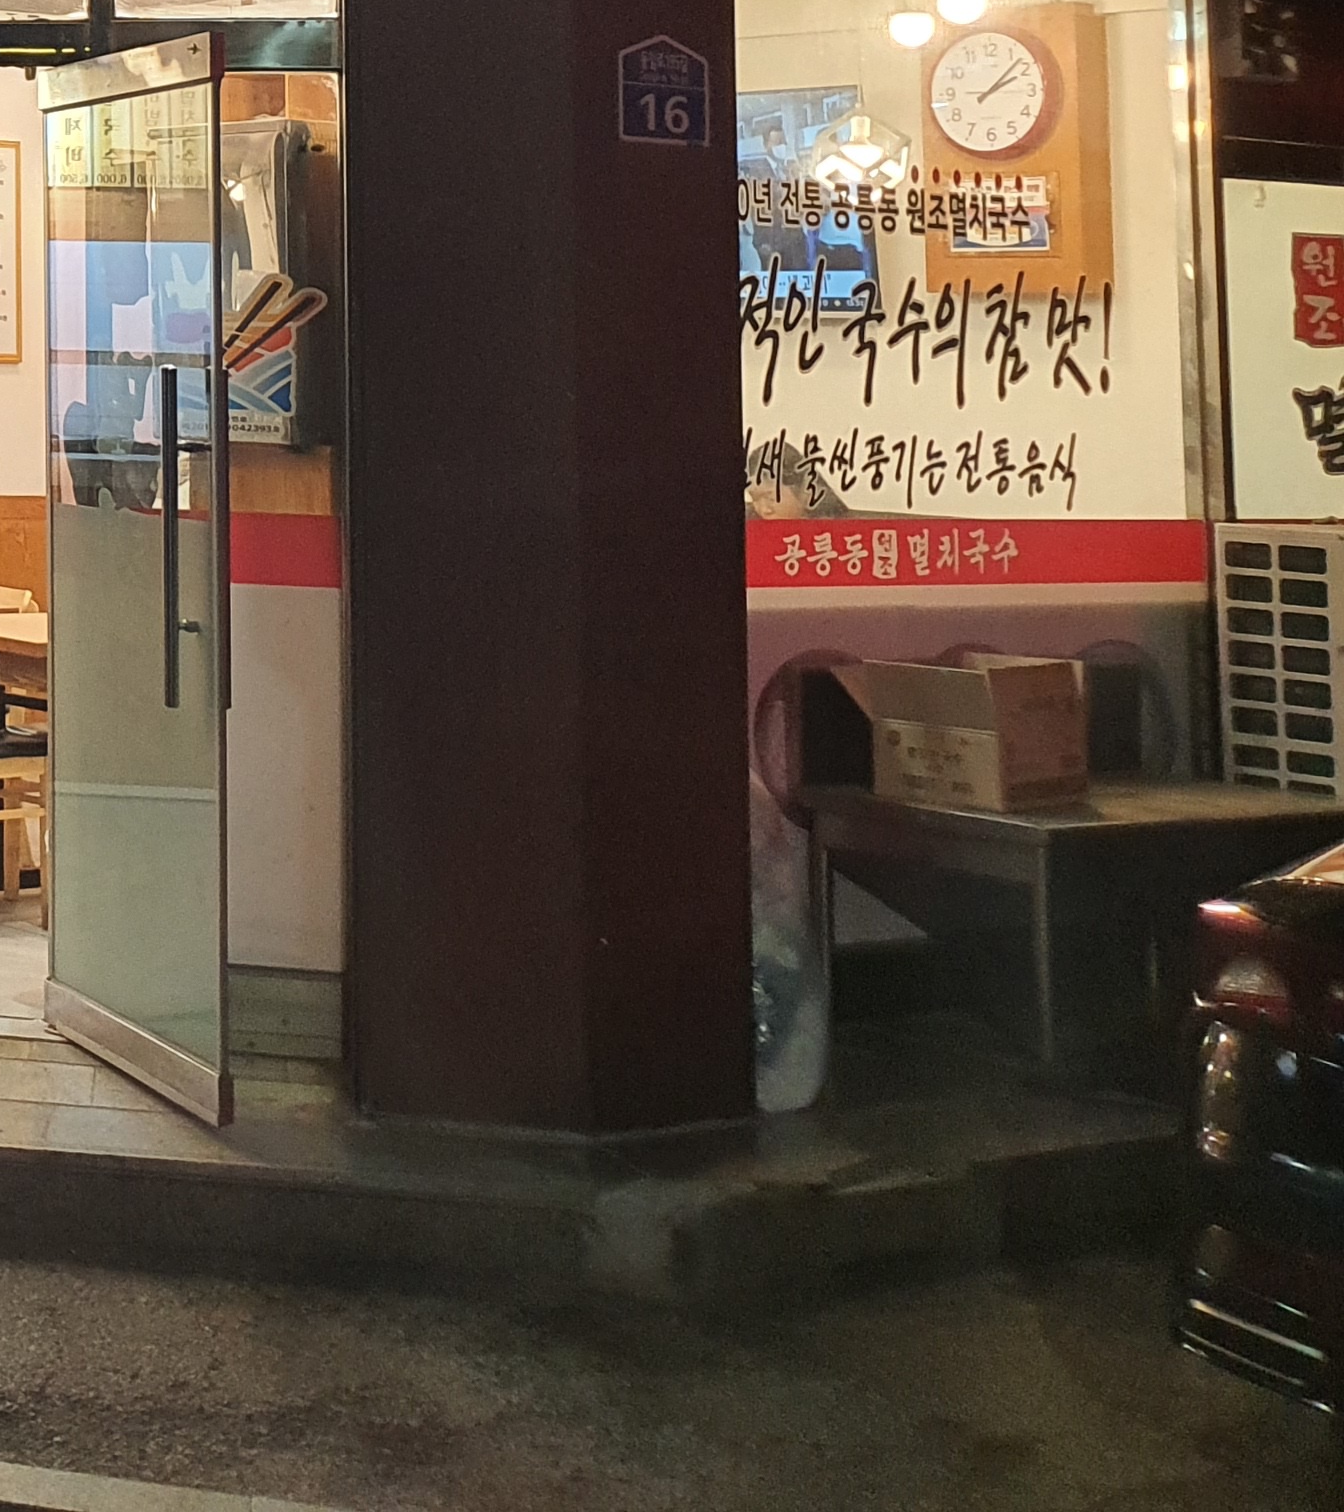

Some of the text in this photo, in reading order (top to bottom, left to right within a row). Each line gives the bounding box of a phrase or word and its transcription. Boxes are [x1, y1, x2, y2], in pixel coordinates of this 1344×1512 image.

[640, 93, 689, 134] 16
[780, 179, 823, 227] 전통
[842, 276, 971, 409] 국수의
[743, 428, 787, 503] 새
[774, 533, 869, 577] 공릉동
[907, 528, 1019, 575] 멸치국수
